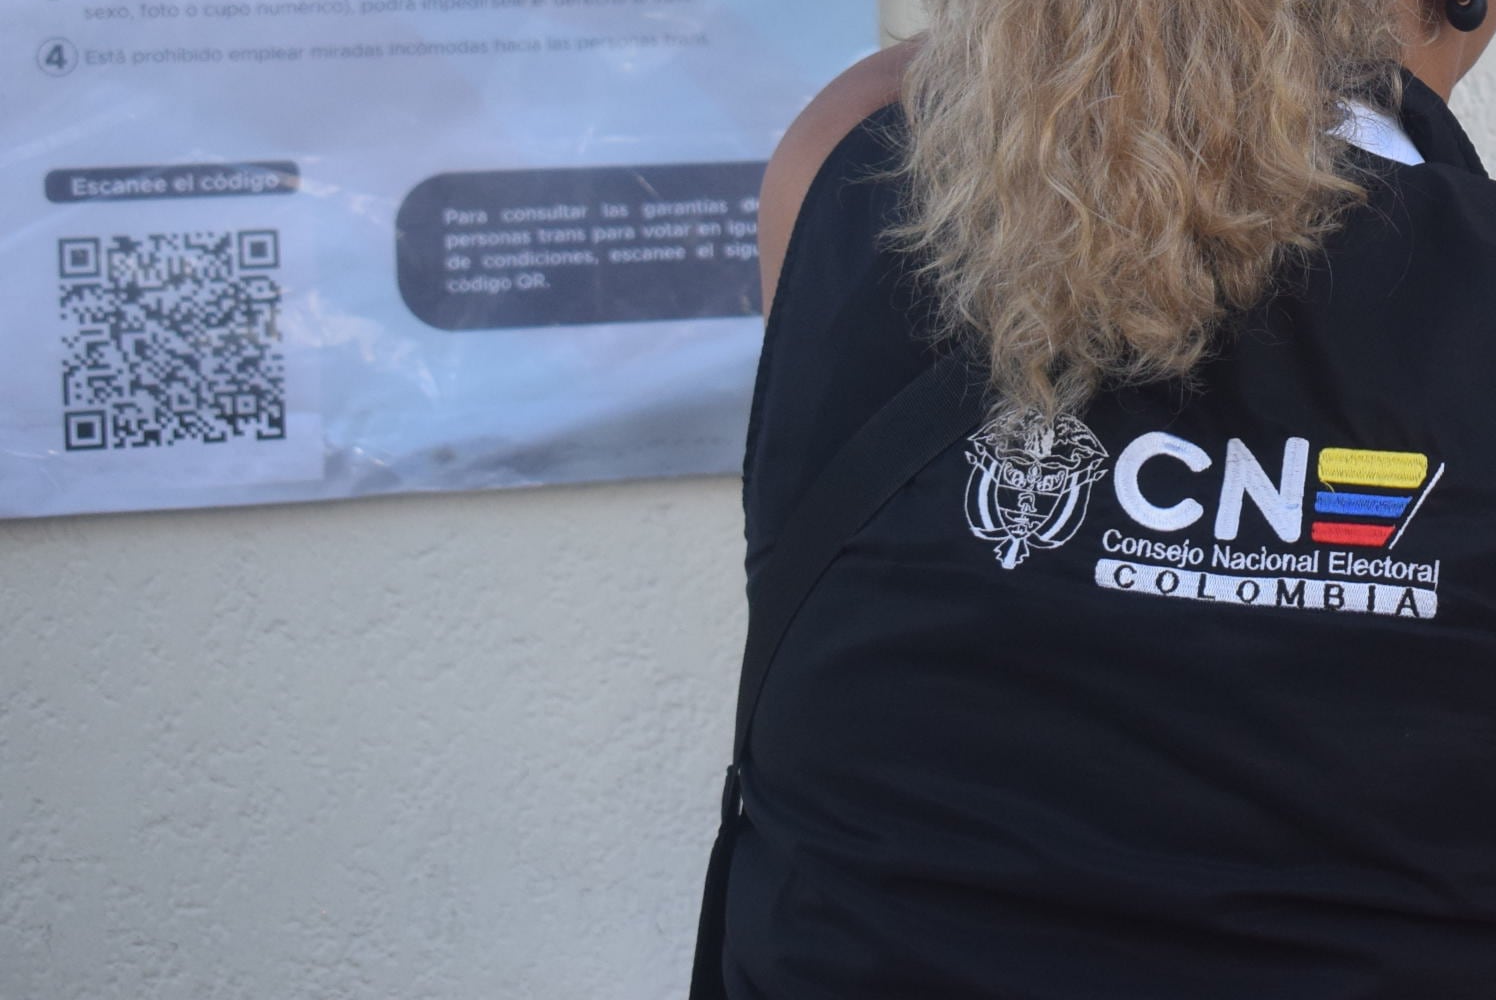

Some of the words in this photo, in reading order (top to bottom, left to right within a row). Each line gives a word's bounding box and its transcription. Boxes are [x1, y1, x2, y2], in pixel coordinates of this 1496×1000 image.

[45, 45, 67, 70] 4
[173, 174, 194, 191] el
[201, 170, 281, 194] código
[443, 208, 488, 225] Para
[503, 205, 588, 222] consultar
[603, 202, 628, 218] las
[643, 199, 728, 219] garantías
[445, 230, 531, 250] personas
[539, 228, 585, 243] trans
[592, 226, 635, 243] para
[643, 222, 690, 239] votar
[699, 223, 721, 237] en
[446, 255, 470, 270] de
[482, 250, 598, 268] condiciones,
[610, 246, 686, 262] escanee
[697, 242, 714, 258] el
[446, 274, 511, 295] código
[516, 273, 551, 290] QR.
[1102, 529, 1204, 567] Consejo
[1213, 545, 1318, 575] Nacional
[1329, 552, 1439, 583] Electoral
[1113, 564, 1421, 618] COLOMBIA
